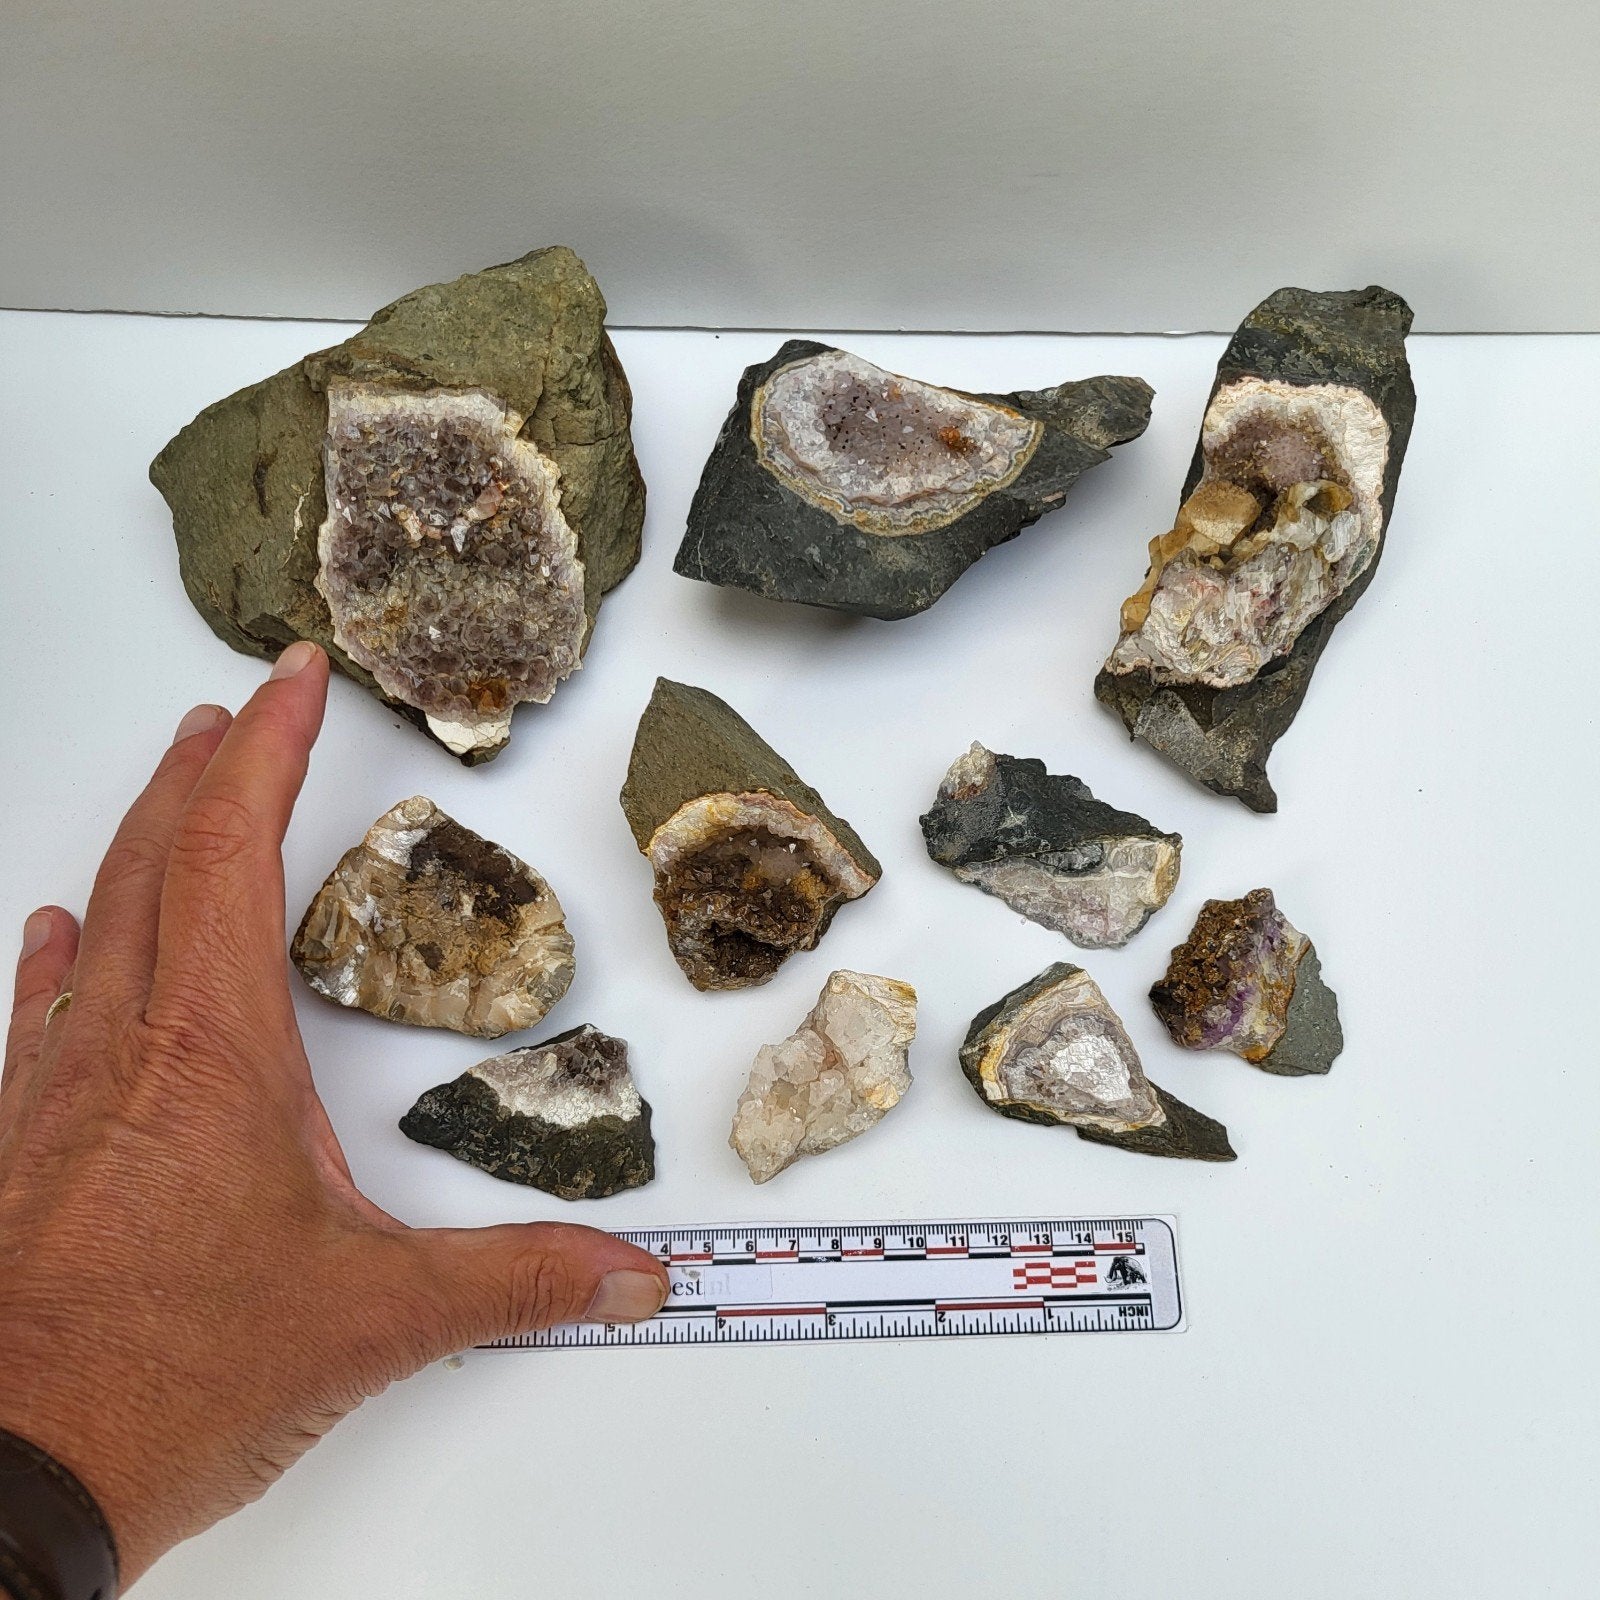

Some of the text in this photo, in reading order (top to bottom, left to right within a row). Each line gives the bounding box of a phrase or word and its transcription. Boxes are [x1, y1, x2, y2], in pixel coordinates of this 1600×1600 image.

[660, 1232, 1133, 1254] 4 5 6 7 8 9 10 11 12 13 14 15
[607, 1306, 1149, 1333] 5 4 3 2 1 INCH
